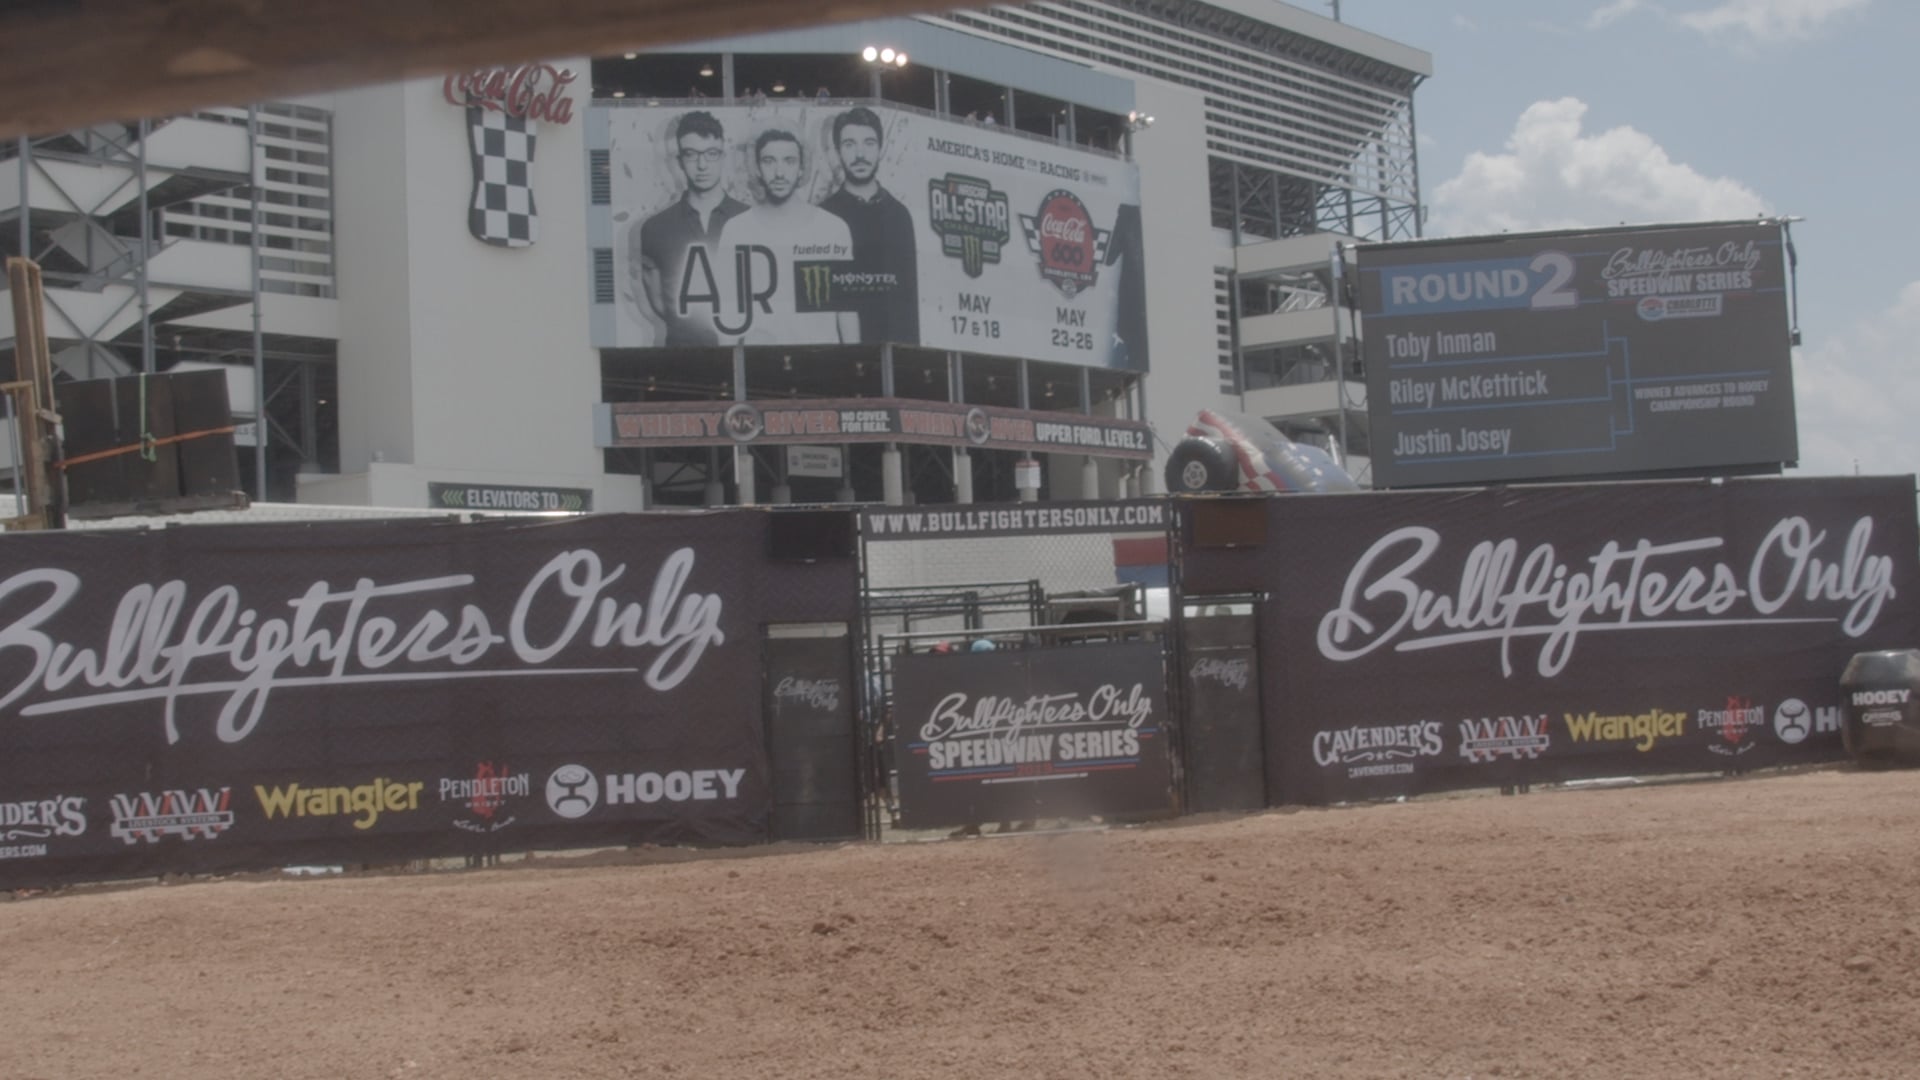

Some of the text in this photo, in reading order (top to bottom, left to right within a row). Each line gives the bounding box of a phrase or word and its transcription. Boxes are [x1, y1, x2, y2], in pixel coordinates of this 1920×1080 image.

[928, 137, 990, 162] AMERICA'S
[992, 150, 1024, 170] HOME
[1039, 160, 1080, 181] RACING
[932, 189, 1007, 231] ALL-STAR
[793, 244, 848, 256] fueled by
[1052, 242, 1084, 267] 600
[1601, 240, 1760, 279] Bullfighters Only
[679, 244, 778, 335] AJR
[832, 272, 897, 285] MONSTER
[1391, 252, 1576, 308] ROUND 2
[1608, 271, 1752, 297] SPEEDWAY SERIES
[959, 293, 991, 314] MAY
[1056, 306, 1086, 327] MAY
[951, 316, 967, 336] 17
[982, 318, 1000, 339] 18
[1051, 329, 1093, 350] 23-26
[1385, 331, 1496, 362] Toby Inman
[1390, 370, 1548, 408] Riley McKettrick
[616, 412, 723, 438] WHISKY
[764, 410, 841, 434] RIVER
[841, 411, 889, 422] NO COVER.
[842, 422, 890, 433] FOR REAL.
[991, 417, 1034, 442] RIVER
[1037, 423, 1073, 443] UPPER
[1074, 426, 1104, 446] FORD.
[1105, 430, 1136, 449] LEVEL
[1394, 427, 1511, 456] Justin Josey
[467, 489, 559, 509] ELEVATORS TO
[869, 506, 1163, 533] WWW.BULLFIGHTERSONLY.COM
[1317, 516, 1896, 679] Bullfighters Only
[510, 547, 725, 691] Only
[1852, 689, 1911, 706] HOOEY
[920, 683, 1152, 745] Bullfighters Only
[1697, 704, 1764, 729] PENDLETON
[1312, 720, 1443, 766] CAVENDER'S
[1565, 709, 1687, 752] Wrangler
[929, 729, 1139, 769] SPEEDWAY SERIES
[1348, 763, 1414, 778] CAVENDERS.COM
[438, 773, 529, 801] PENDLETON
[606, 768, 746, 802] HOOEY
[255, 777, 423, 830] Wrangler
